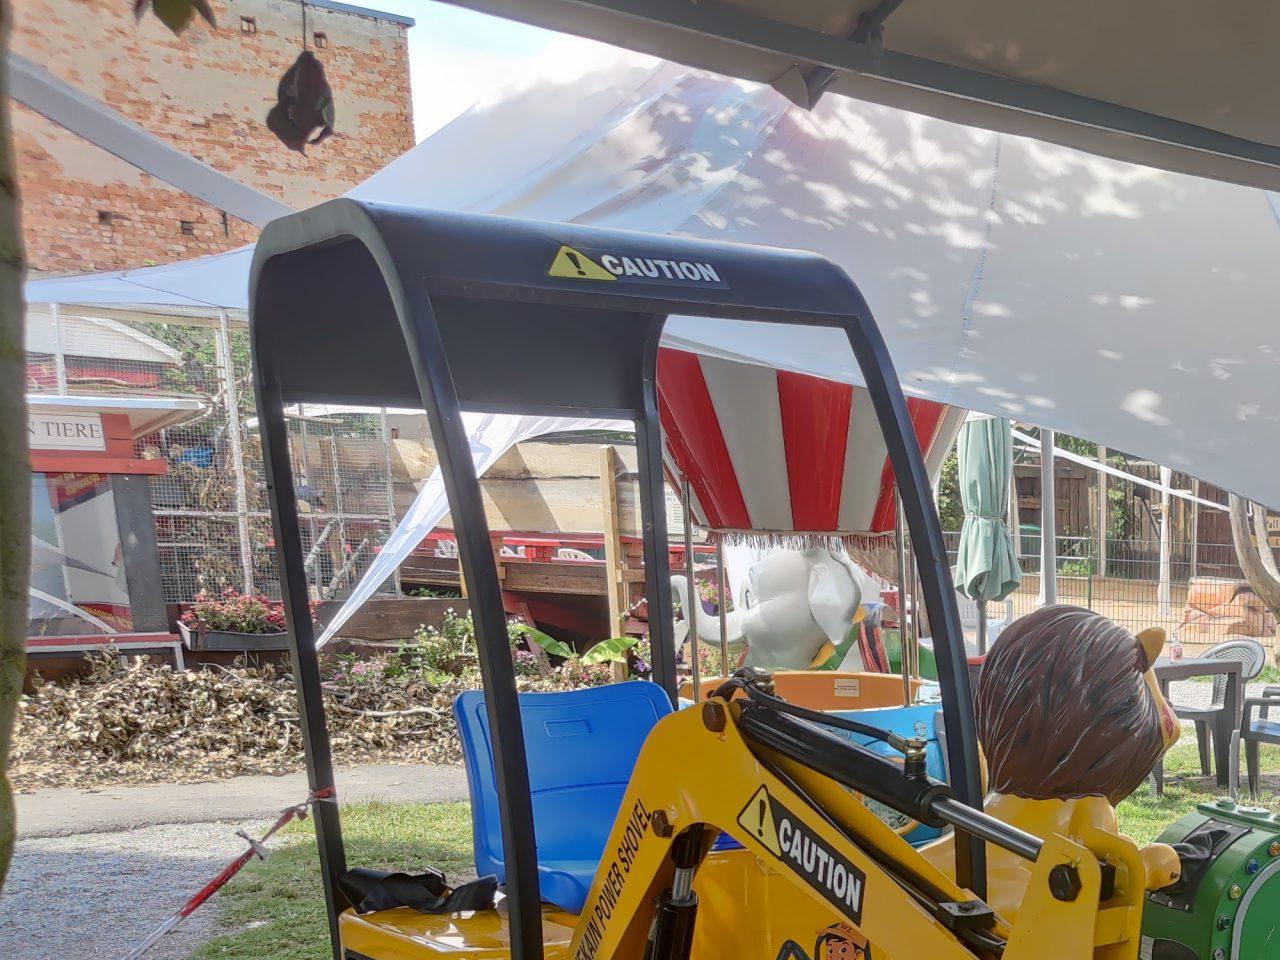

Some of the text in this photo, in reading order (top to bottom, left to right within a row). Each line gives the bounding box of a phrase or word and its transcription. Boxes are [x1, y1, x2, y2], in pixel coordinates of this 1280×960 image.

[602, 254, 721, 282] CAUTION
[42, 421, 101, 439] TIERE
[595, 862, 626, 931] POWER
[618, 798, 651, 873] SHOVEL
[779, 818, 861, 912] CAUTION
